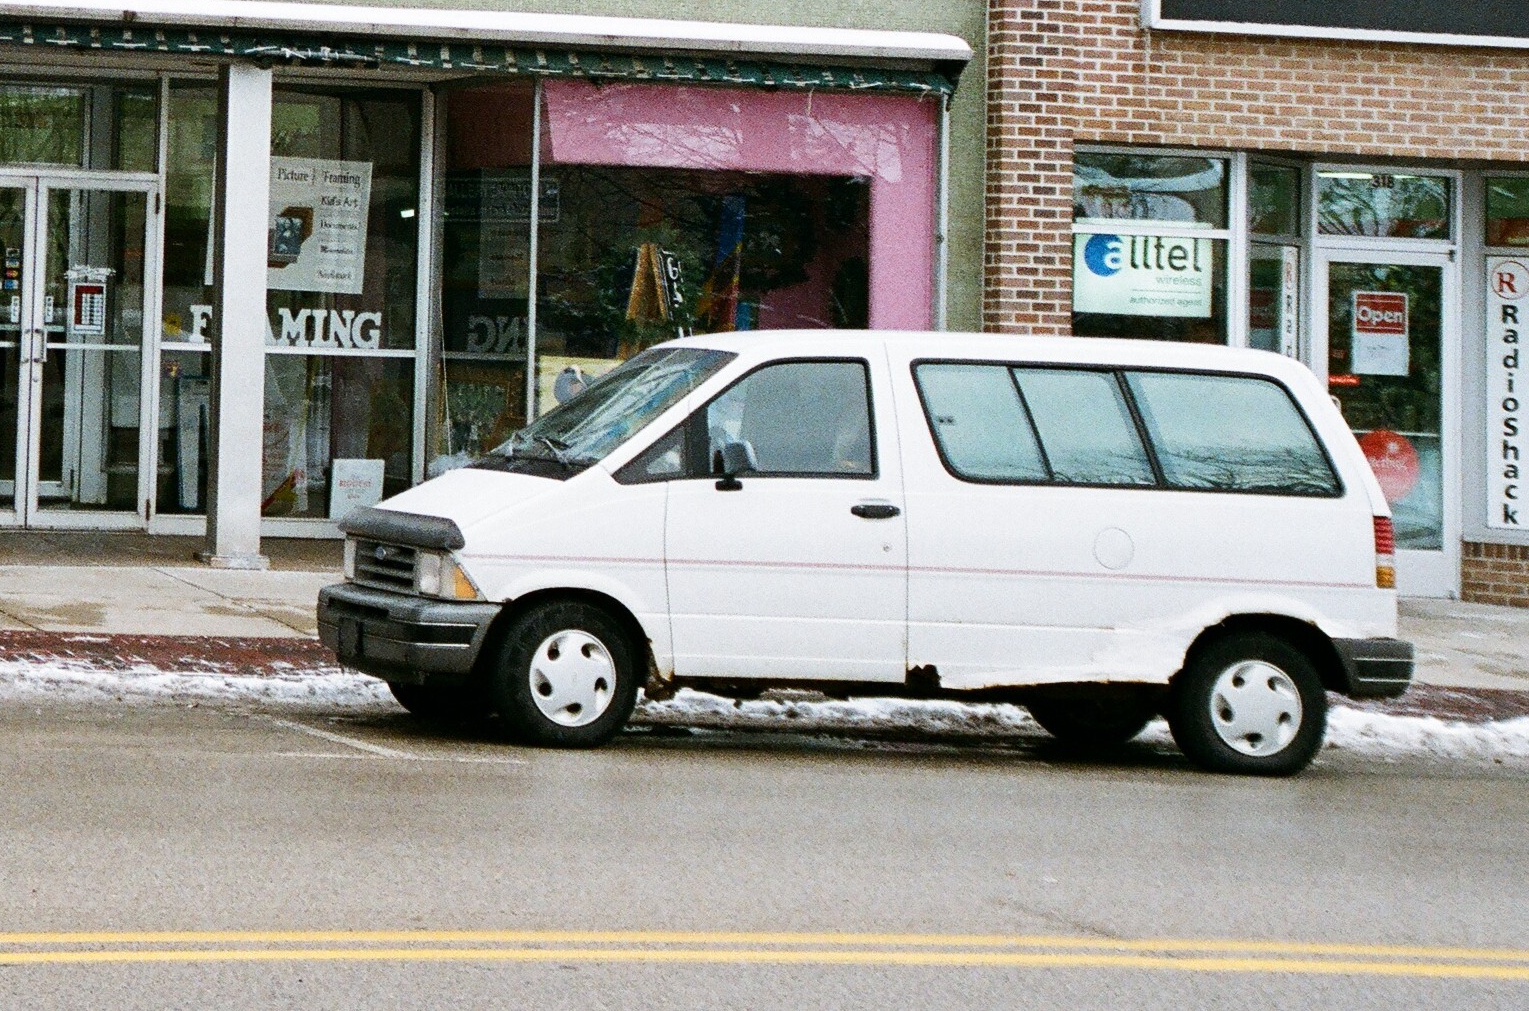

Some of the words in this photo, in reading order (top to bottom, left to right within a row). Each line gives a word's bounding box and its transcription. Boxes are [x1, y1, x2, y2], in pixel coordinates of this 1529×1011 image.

[277, 168, 309, 182] Picture
[322, 171, 361, 188] Framing
[1103, 235, 1202, 273] alltel
[1156, 275, 1202, 287] wireless
[1358, 305, 1403, 325] Open
[188, 304, 381, 350] FMING
